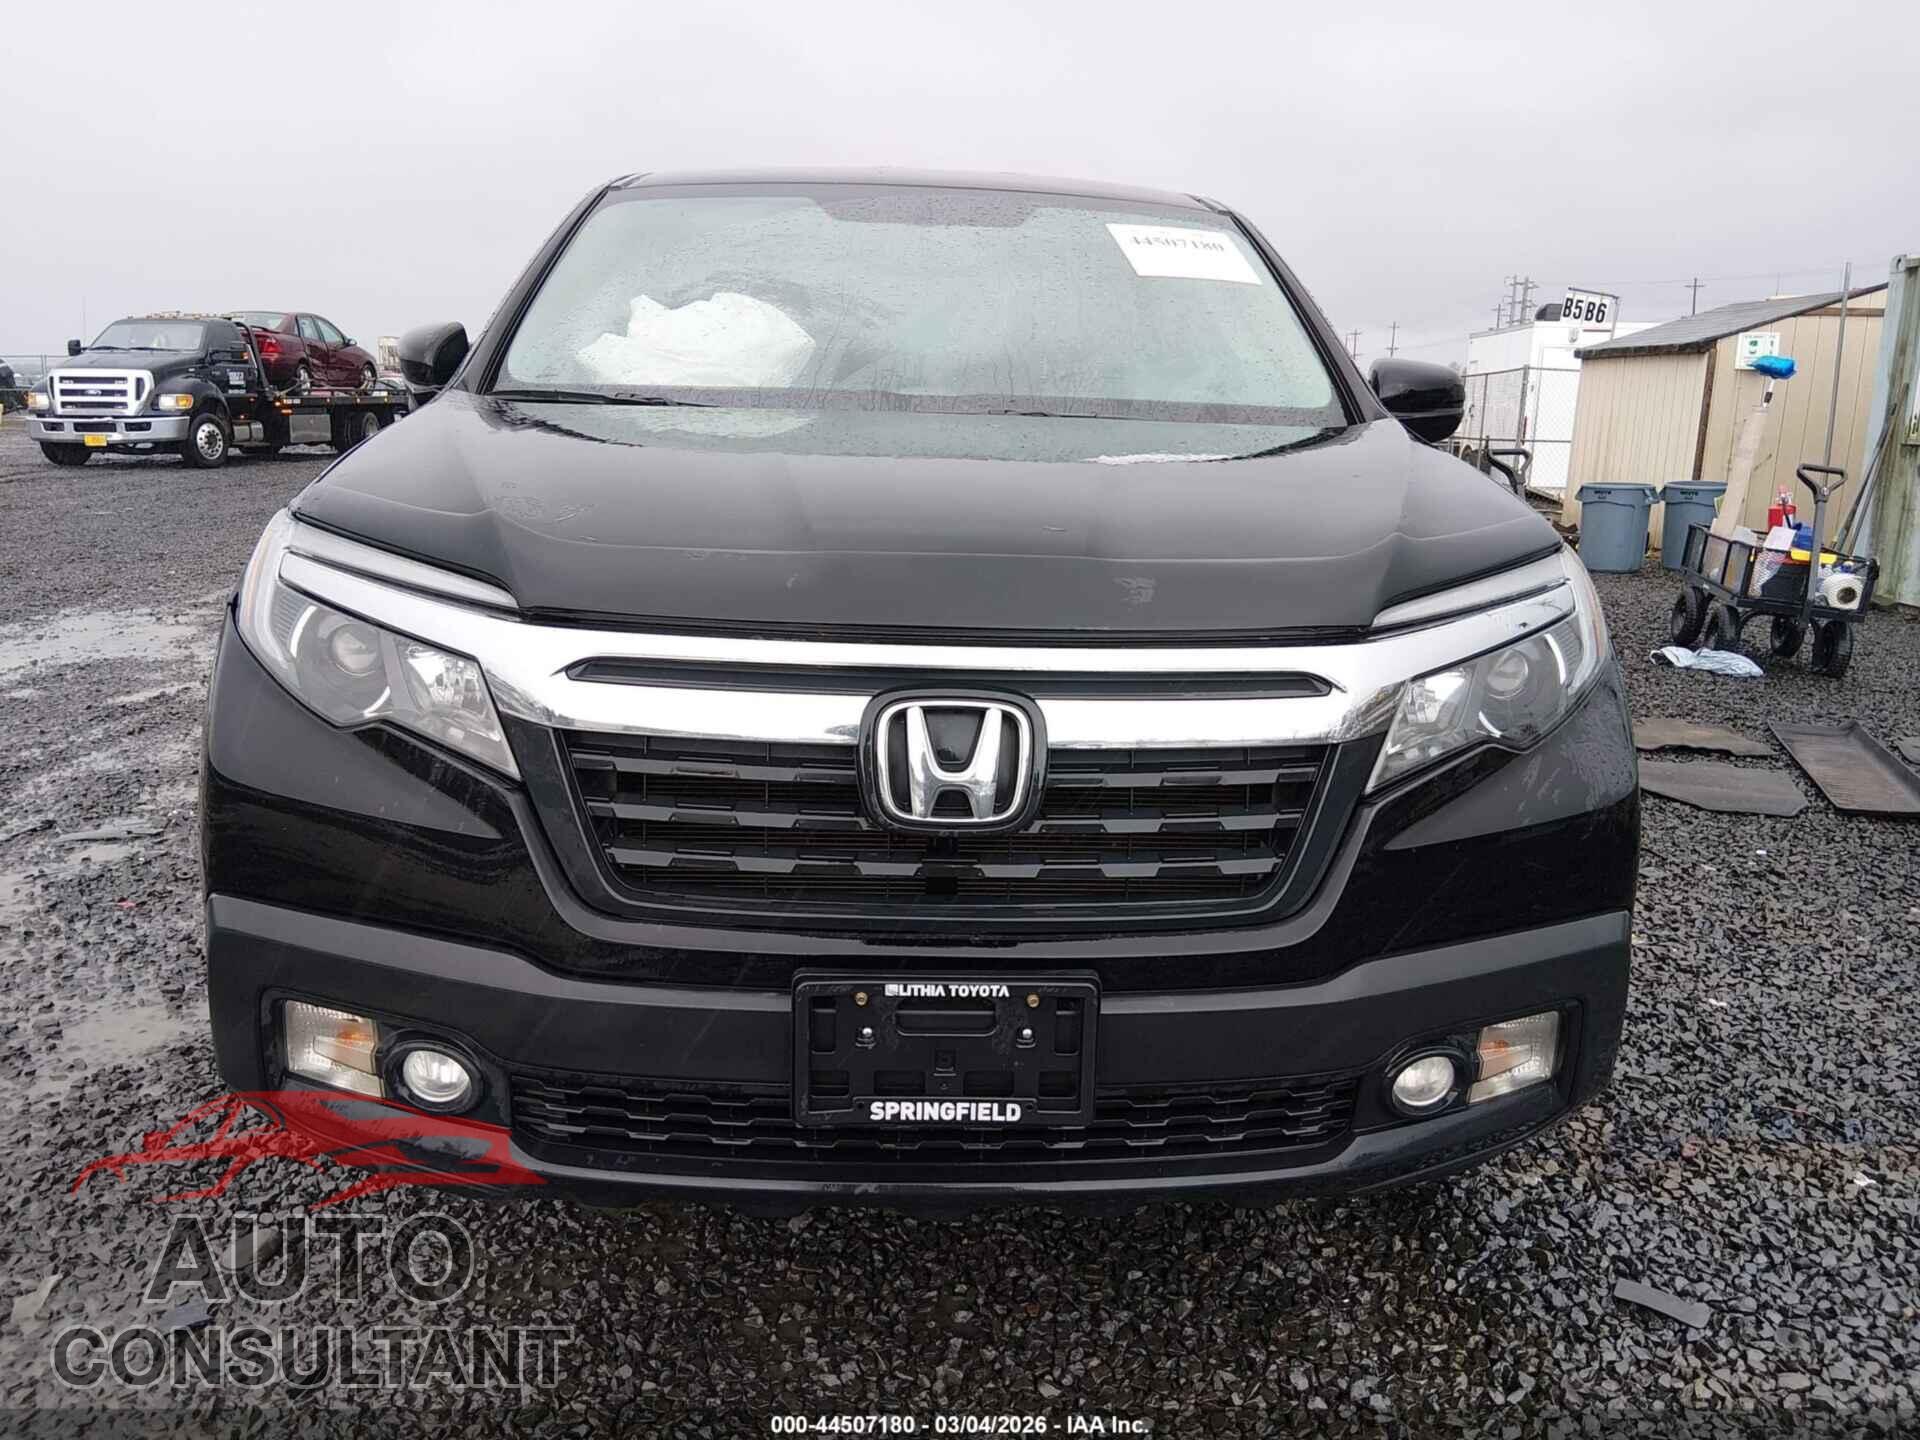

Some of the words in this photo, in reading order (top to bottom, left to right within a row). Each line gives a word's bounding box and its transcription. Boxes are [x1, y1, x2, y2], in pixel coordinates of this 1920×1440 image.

[1562, 297, 1584, 320] B5
[1584, 301, 1607, 324] B6
[899, 984, 945, 998] LITHIA
[948, 984, 1010, 998] TOYOTA
[869, 1101, 1022, 1122] SPRINGFIELD
